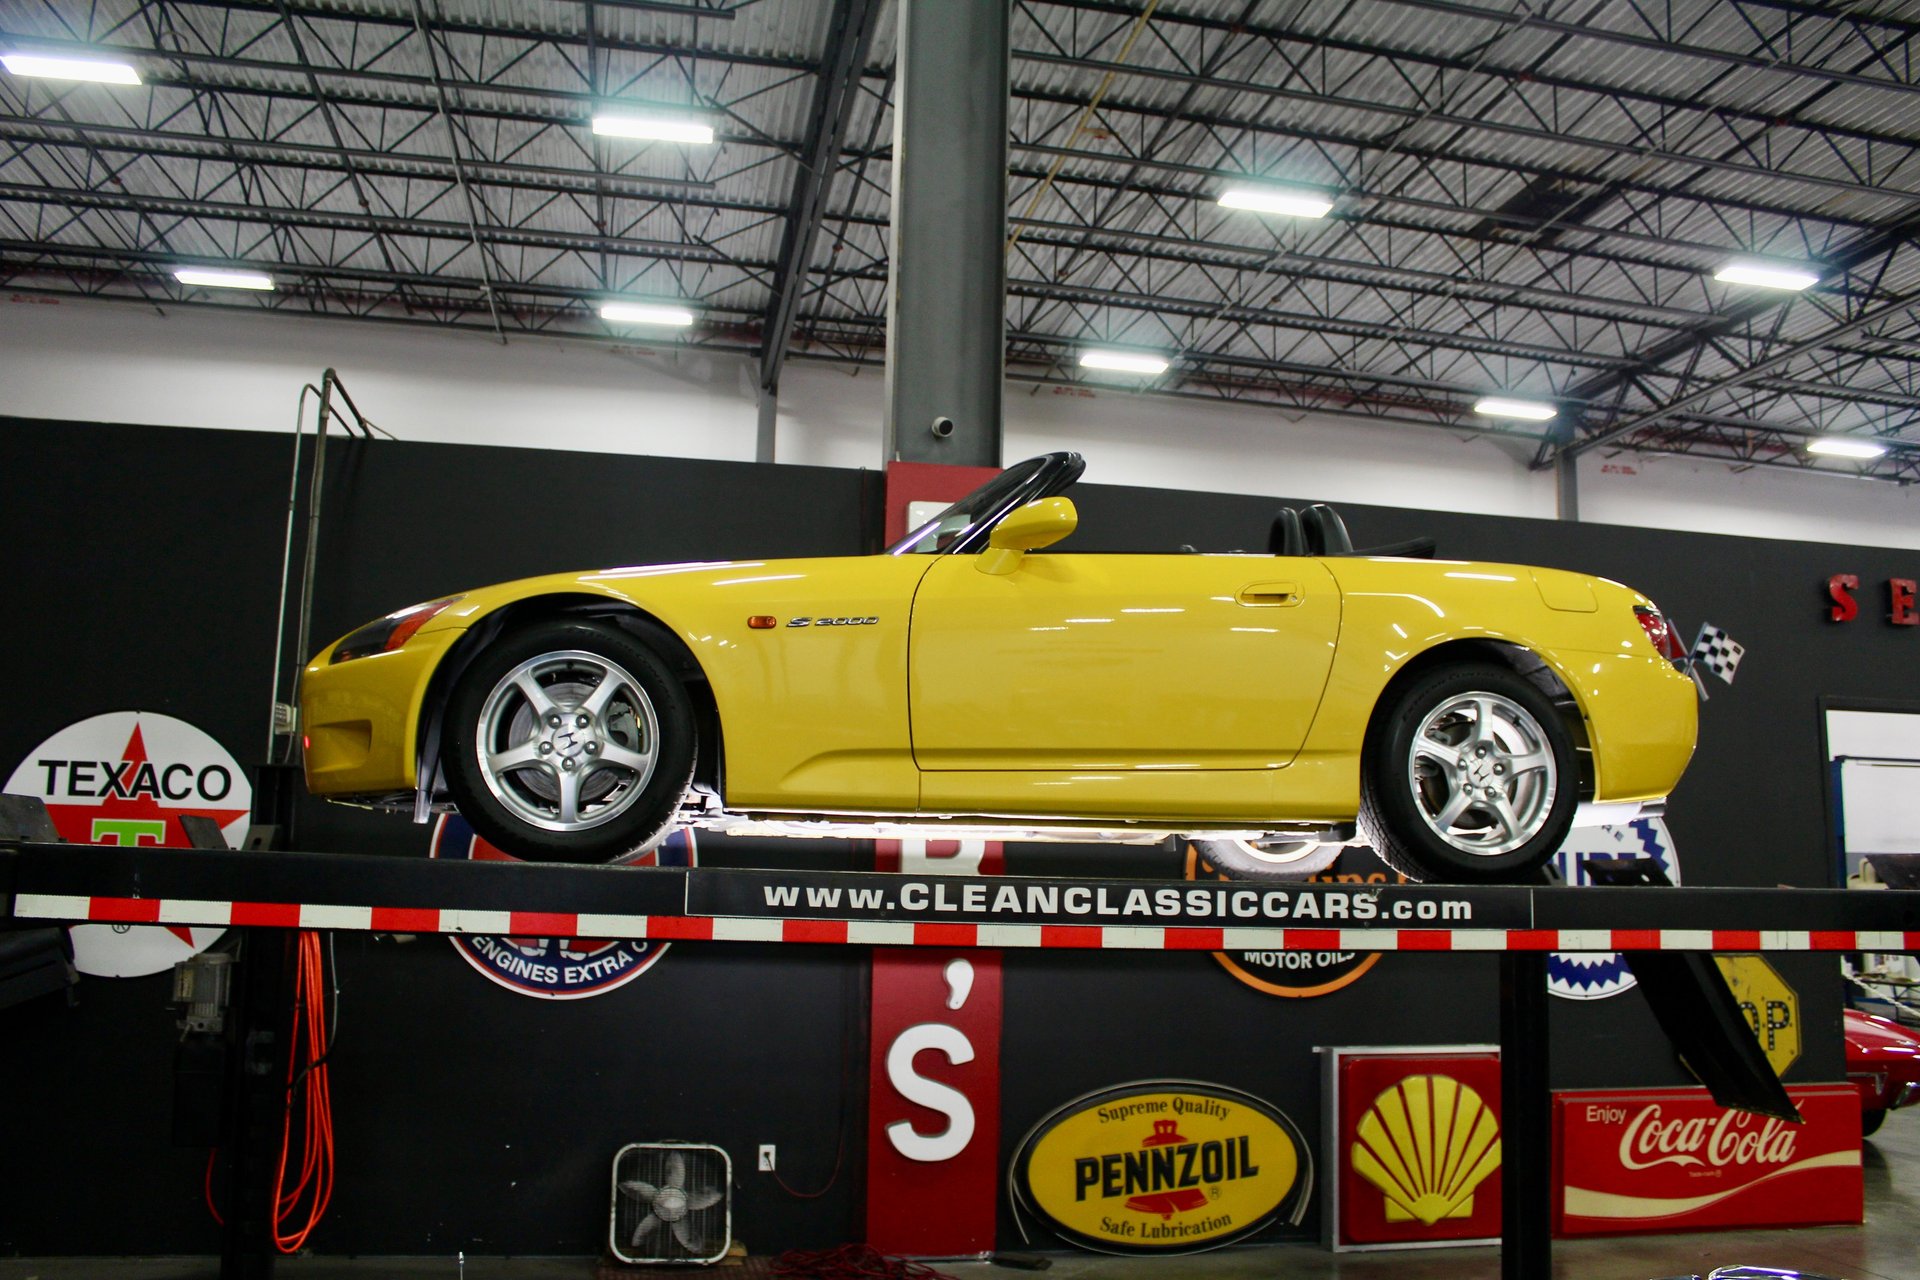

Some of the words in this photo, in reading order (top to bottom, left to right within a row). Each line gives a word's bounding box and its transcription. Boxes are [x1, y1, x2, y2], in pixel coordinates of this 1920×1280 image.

[38, 760, 232, 801] TEXACO
[764, 883, 1472, 920] www.CLEANCLASSICCARS.com
[472, 936, 558, 984] ENGINES
[564, 950, 633, 984] EXTRA
[1244, 952, 1312, 969] MOTOR
[1097, 1097, 1168, 1123] Supreme
[1172, 1097, 1230, 1120] Quality
[1586, 1105, 1627, 1125] Enjoy
[1075, 1135, 1259, 1202] PENNZOIL
[1100, 1216, 1135, 1237] Safe
[1140, 1214, 1232, 1238] Lubrication
